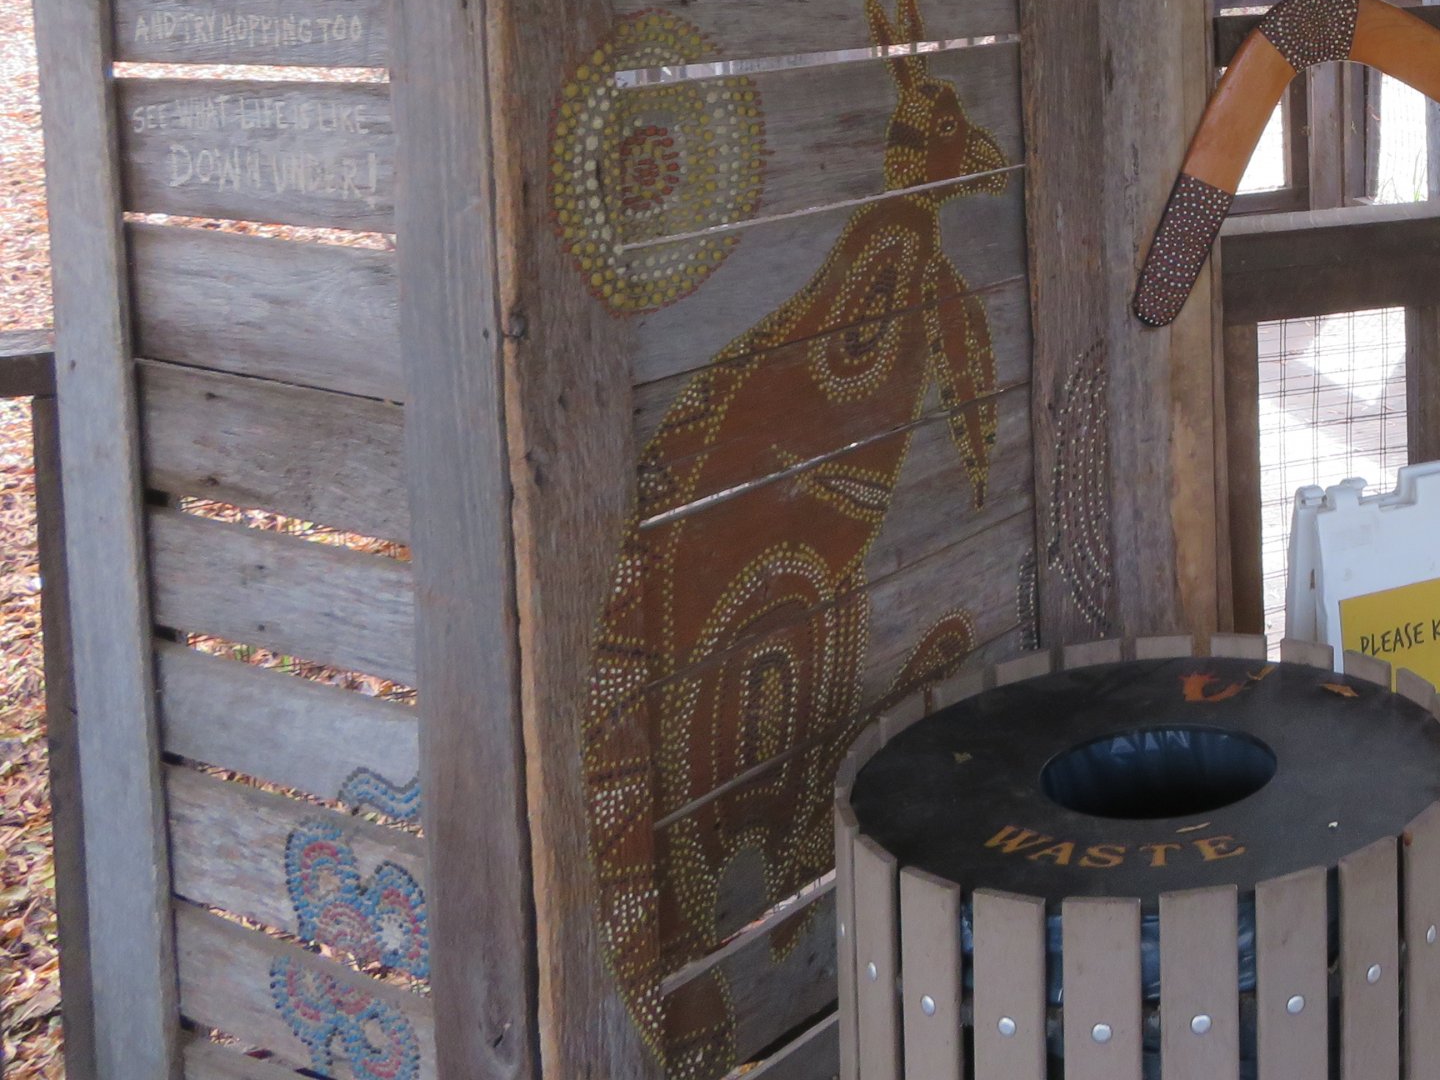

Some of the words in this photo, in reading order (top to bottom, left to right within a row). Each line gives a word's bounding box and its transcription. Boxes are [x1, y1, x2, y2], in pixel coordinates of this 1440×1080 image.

[134, 12, 176, 44] AND
[222, 13, 313, 47] HOPPING
[316, 15, 363, 45] TOO
[133, 105, 168, 134] SEE
[240, 97, 289, 131] LIFE
[318, 102, 370, 135] LIKE
[168, 143, 263, 194] DOWN
[1360, 622, 1425, 656] PLEASE
[984, 825, 1247, 869] WASTE
